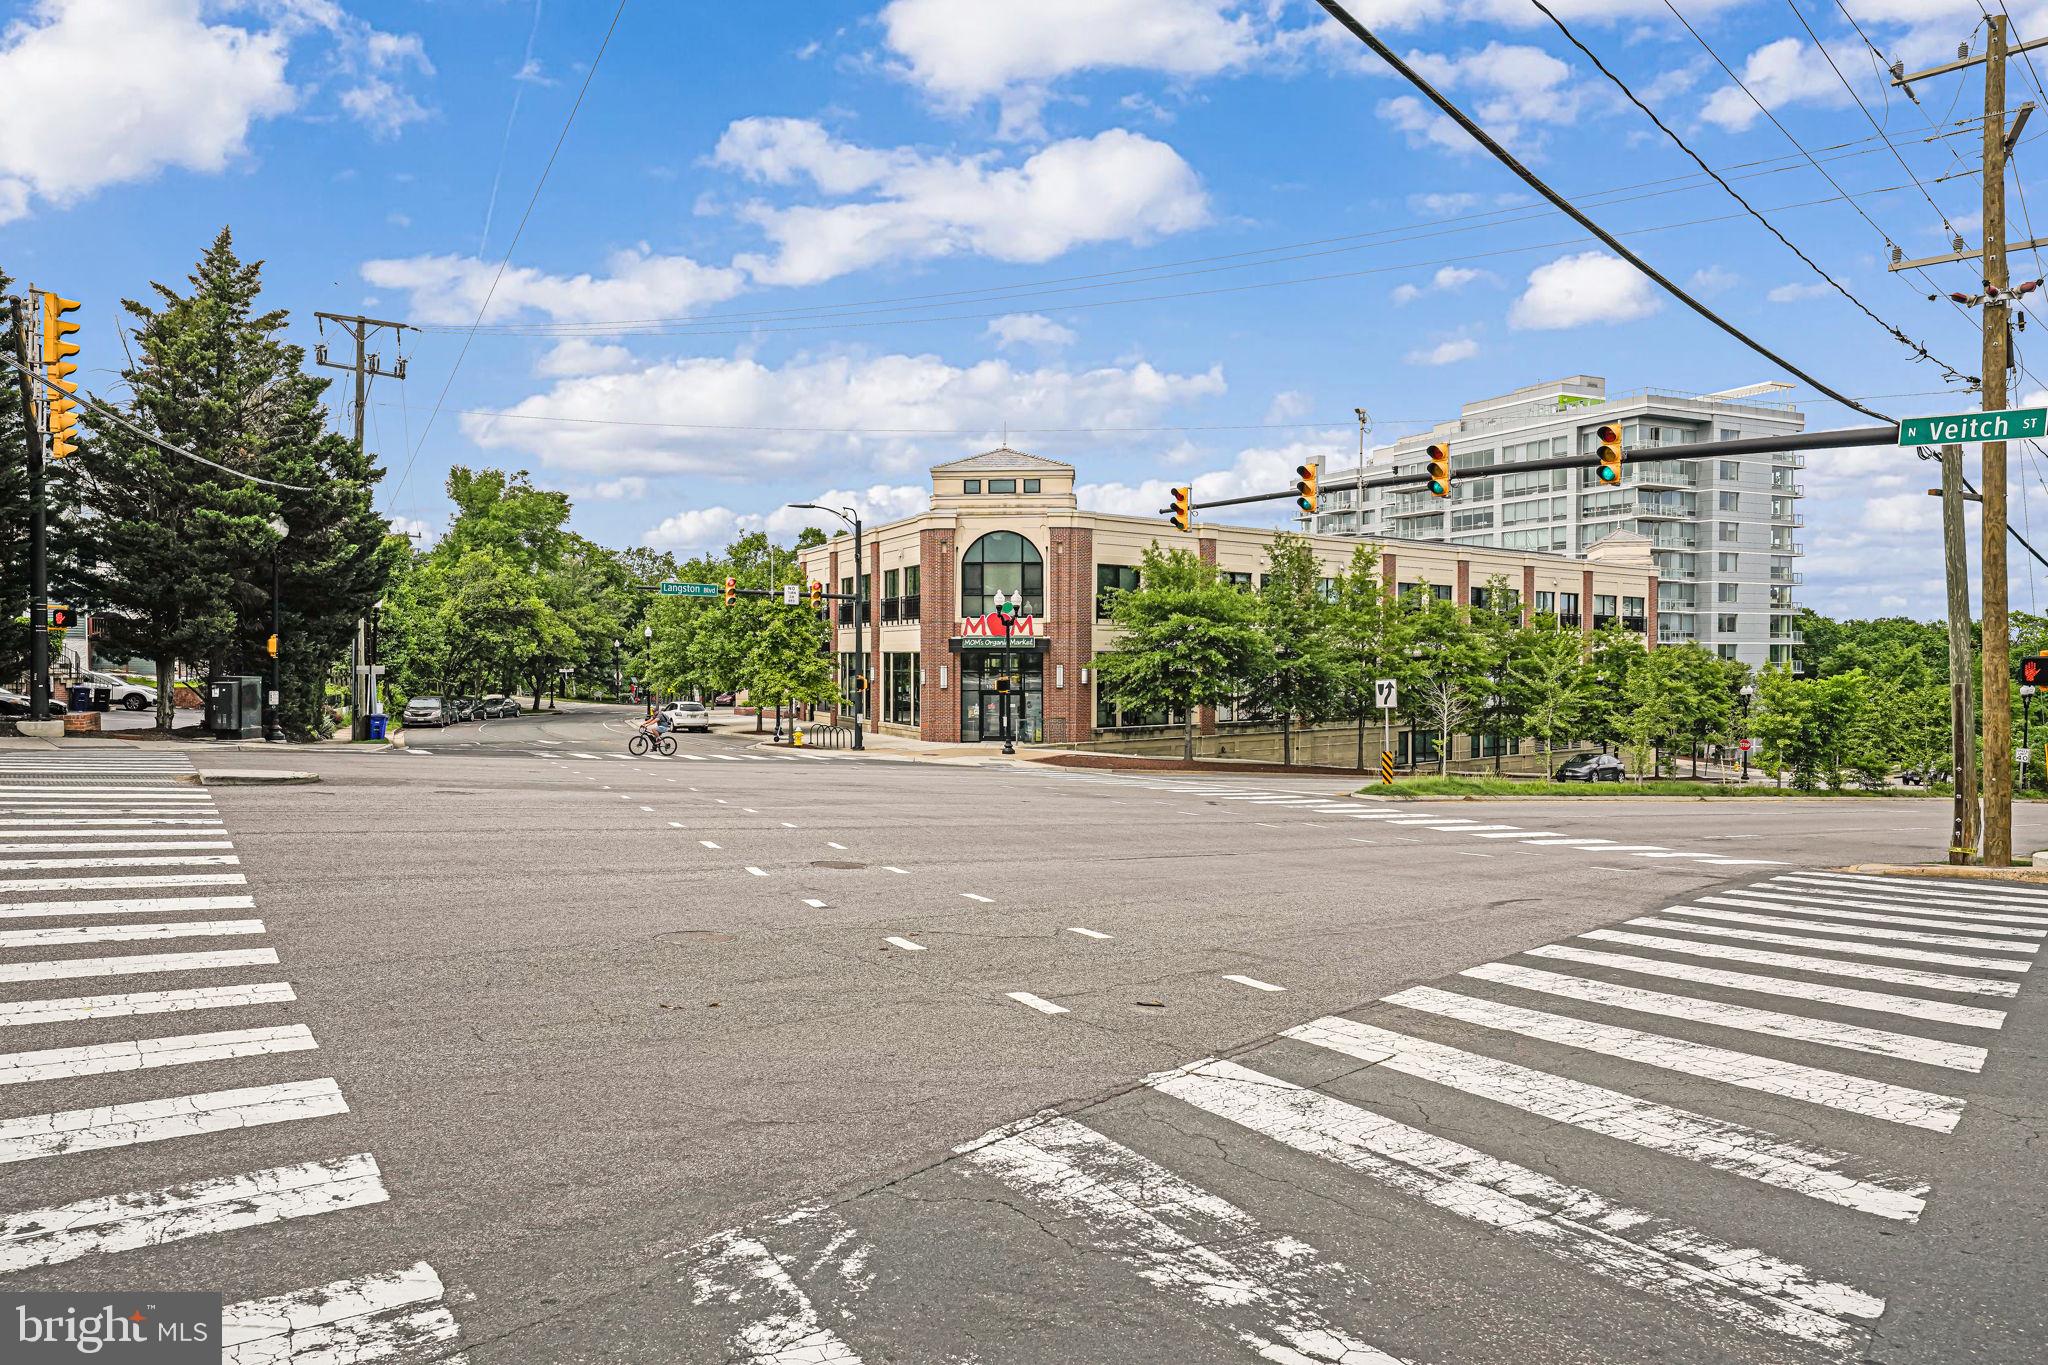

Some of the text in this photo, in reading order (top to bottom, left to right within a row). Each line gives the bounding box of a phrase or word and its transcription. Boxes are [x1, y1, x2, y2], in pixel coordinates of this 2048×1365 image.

[1908, 416, 2038, 441] N Veitch ST
[663, 583, 700, 594] Langston
[1009, 638, 1034, 646] Market
